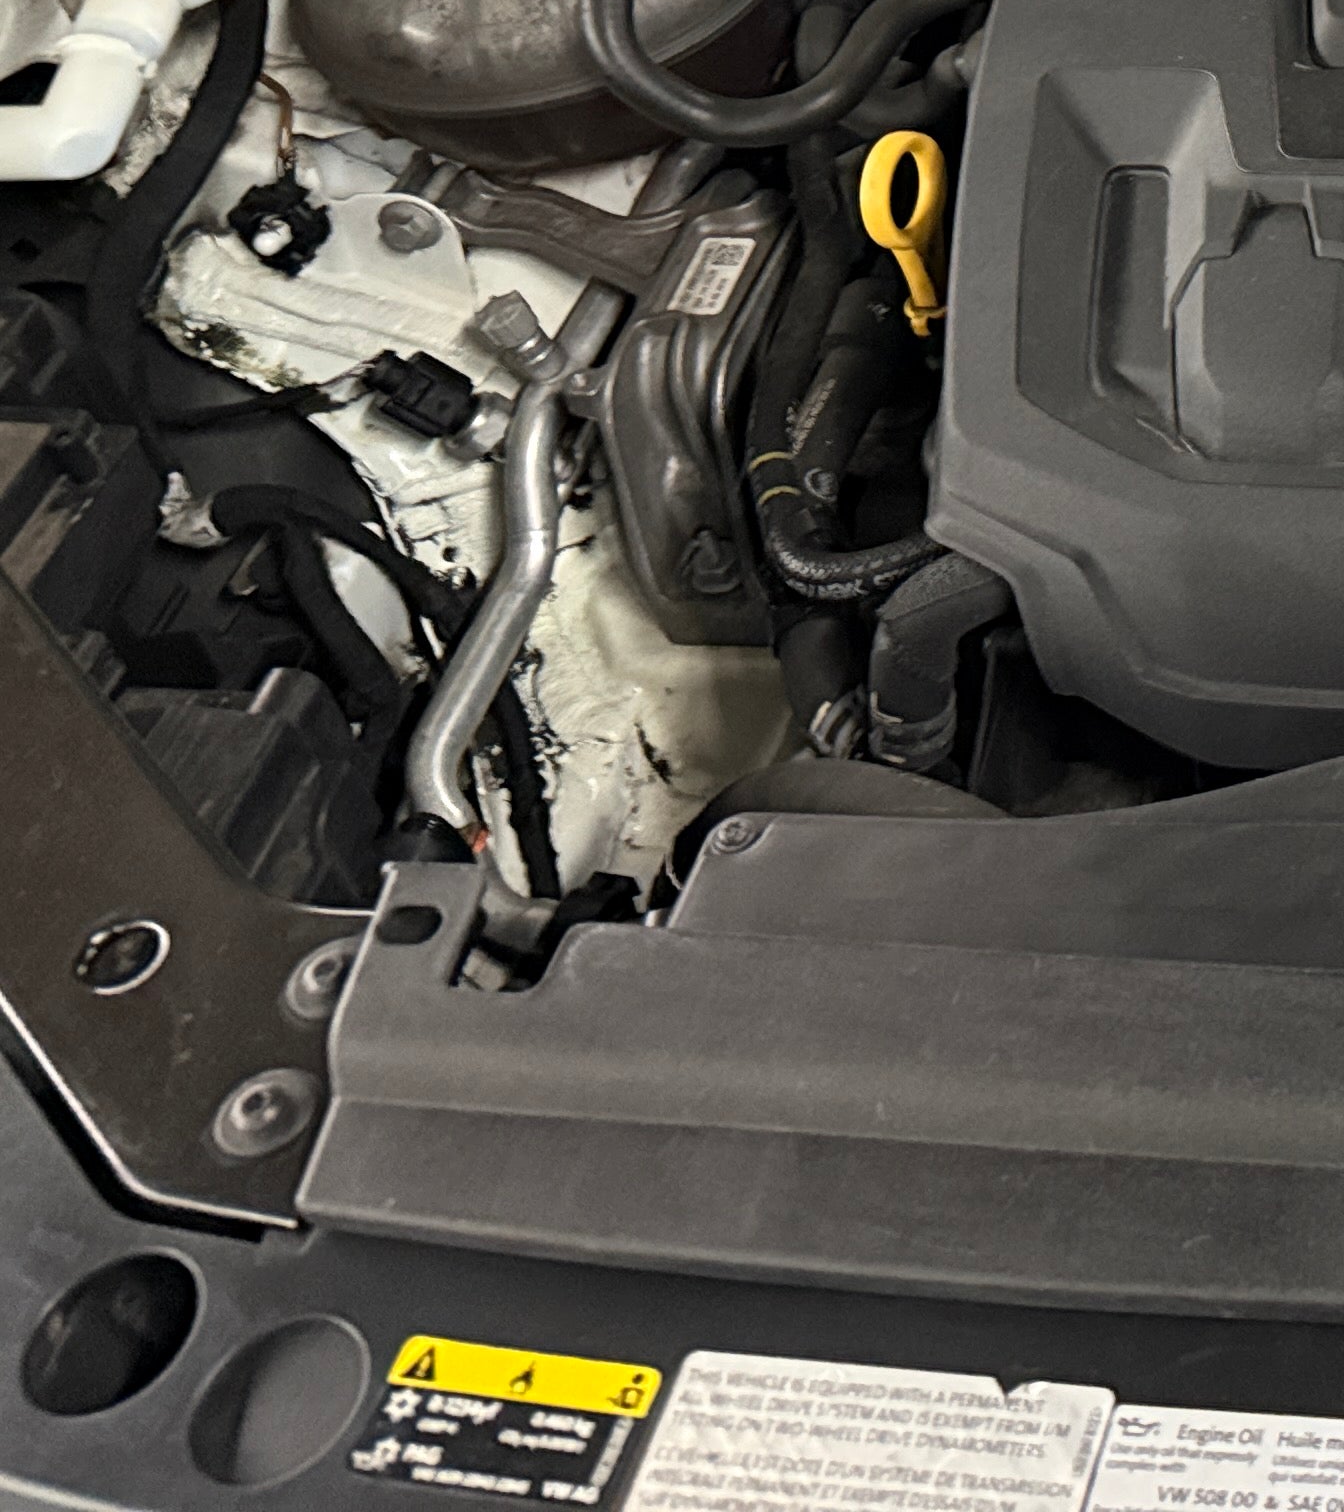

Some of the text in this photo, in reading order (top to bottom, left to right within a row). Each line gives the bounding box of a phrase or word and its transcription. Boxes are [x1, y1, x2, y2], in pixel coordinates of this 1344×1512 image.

[933, 1391, 945, 1403] A
[995, 1418, 1042, 1435] FROM
[1176, 1423, 1265, 1446] Engine Oil
[1277, 1431, 1323, 1450] Huile
[1157, 1485, 1191, 1503] VW
[1194, 1488, 1229, 1506] 508
[1231, 1491, 1259, 1508] 00
[1263, 1495, 1280, 1510] &
[1287, 1494, 1323, 1512] SAE
